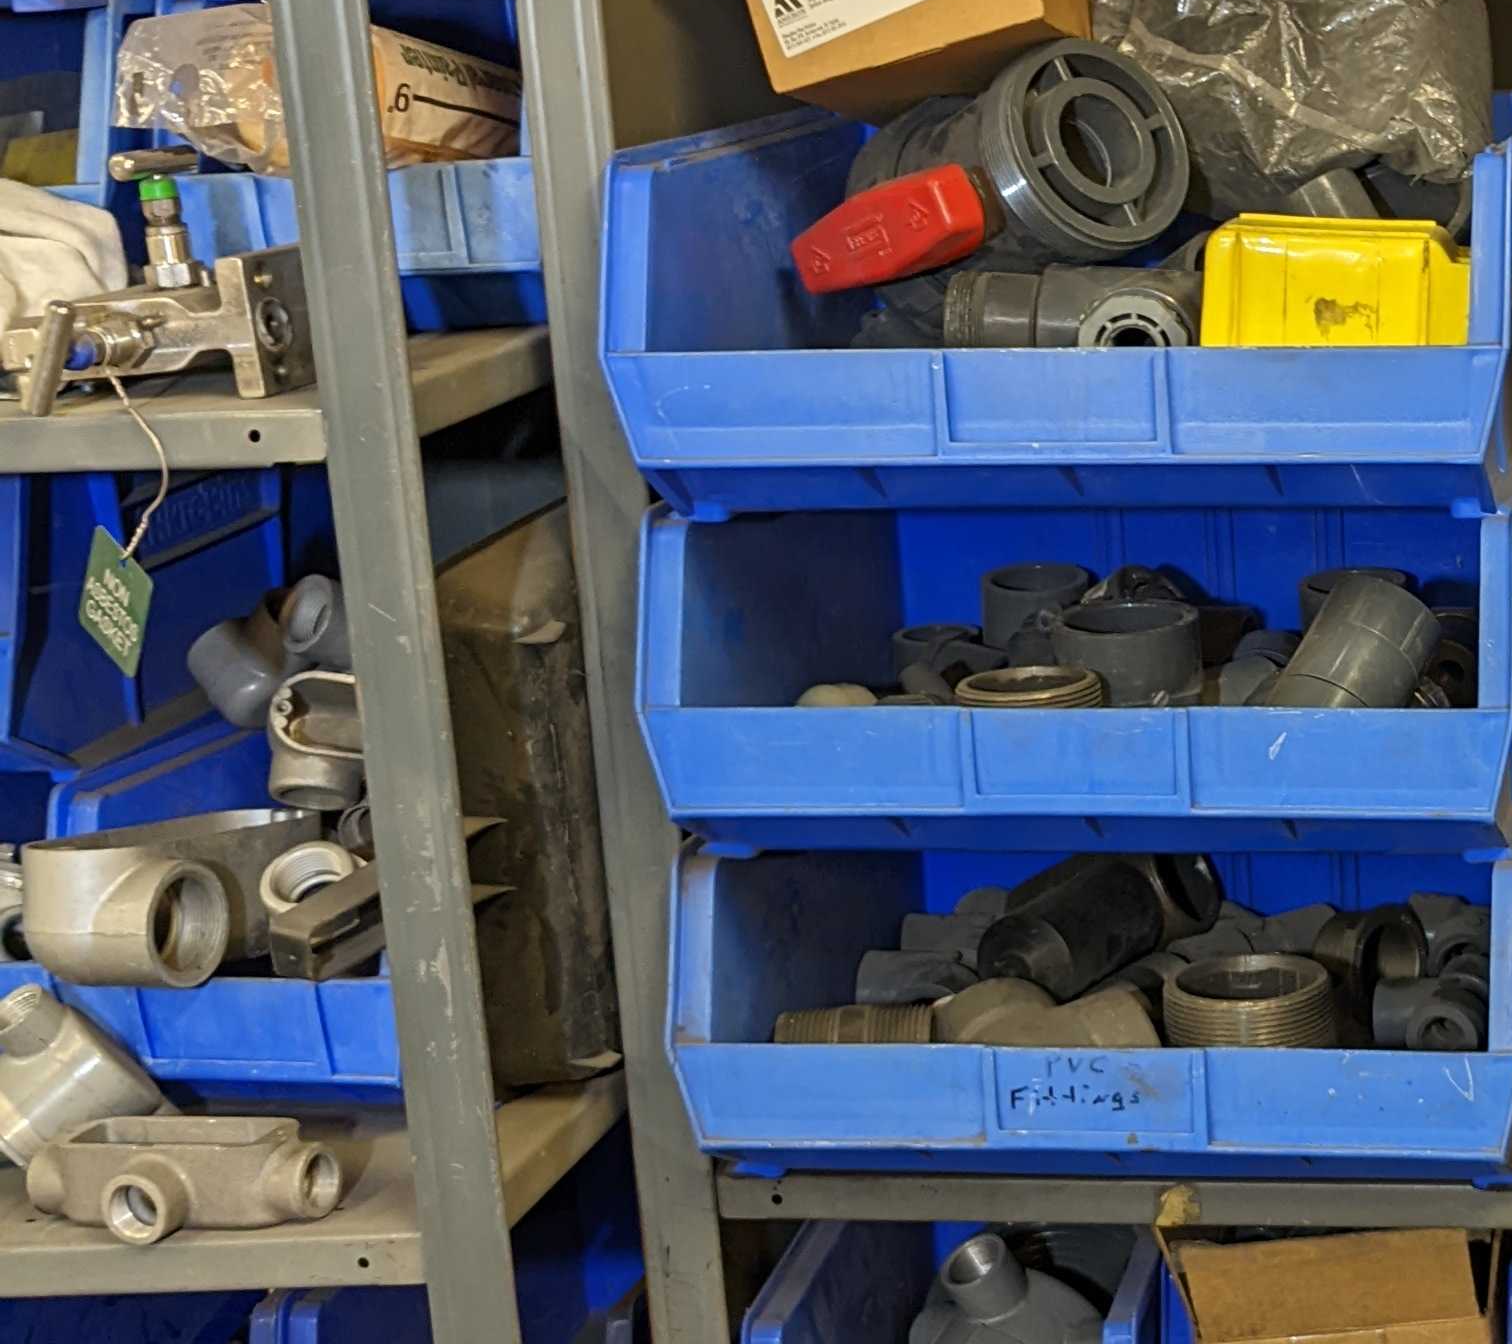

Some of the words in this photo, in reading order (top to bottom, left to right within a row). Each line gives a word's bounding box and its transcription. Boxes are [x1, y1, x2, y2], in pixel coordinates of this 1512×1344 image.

[86, 576, 139, 642] ASBESTOS
[103, 568, 131, 607] NON
[86, 599, 133, 657] GASKET
[1047, 1055, 1107, 1077] PVC
